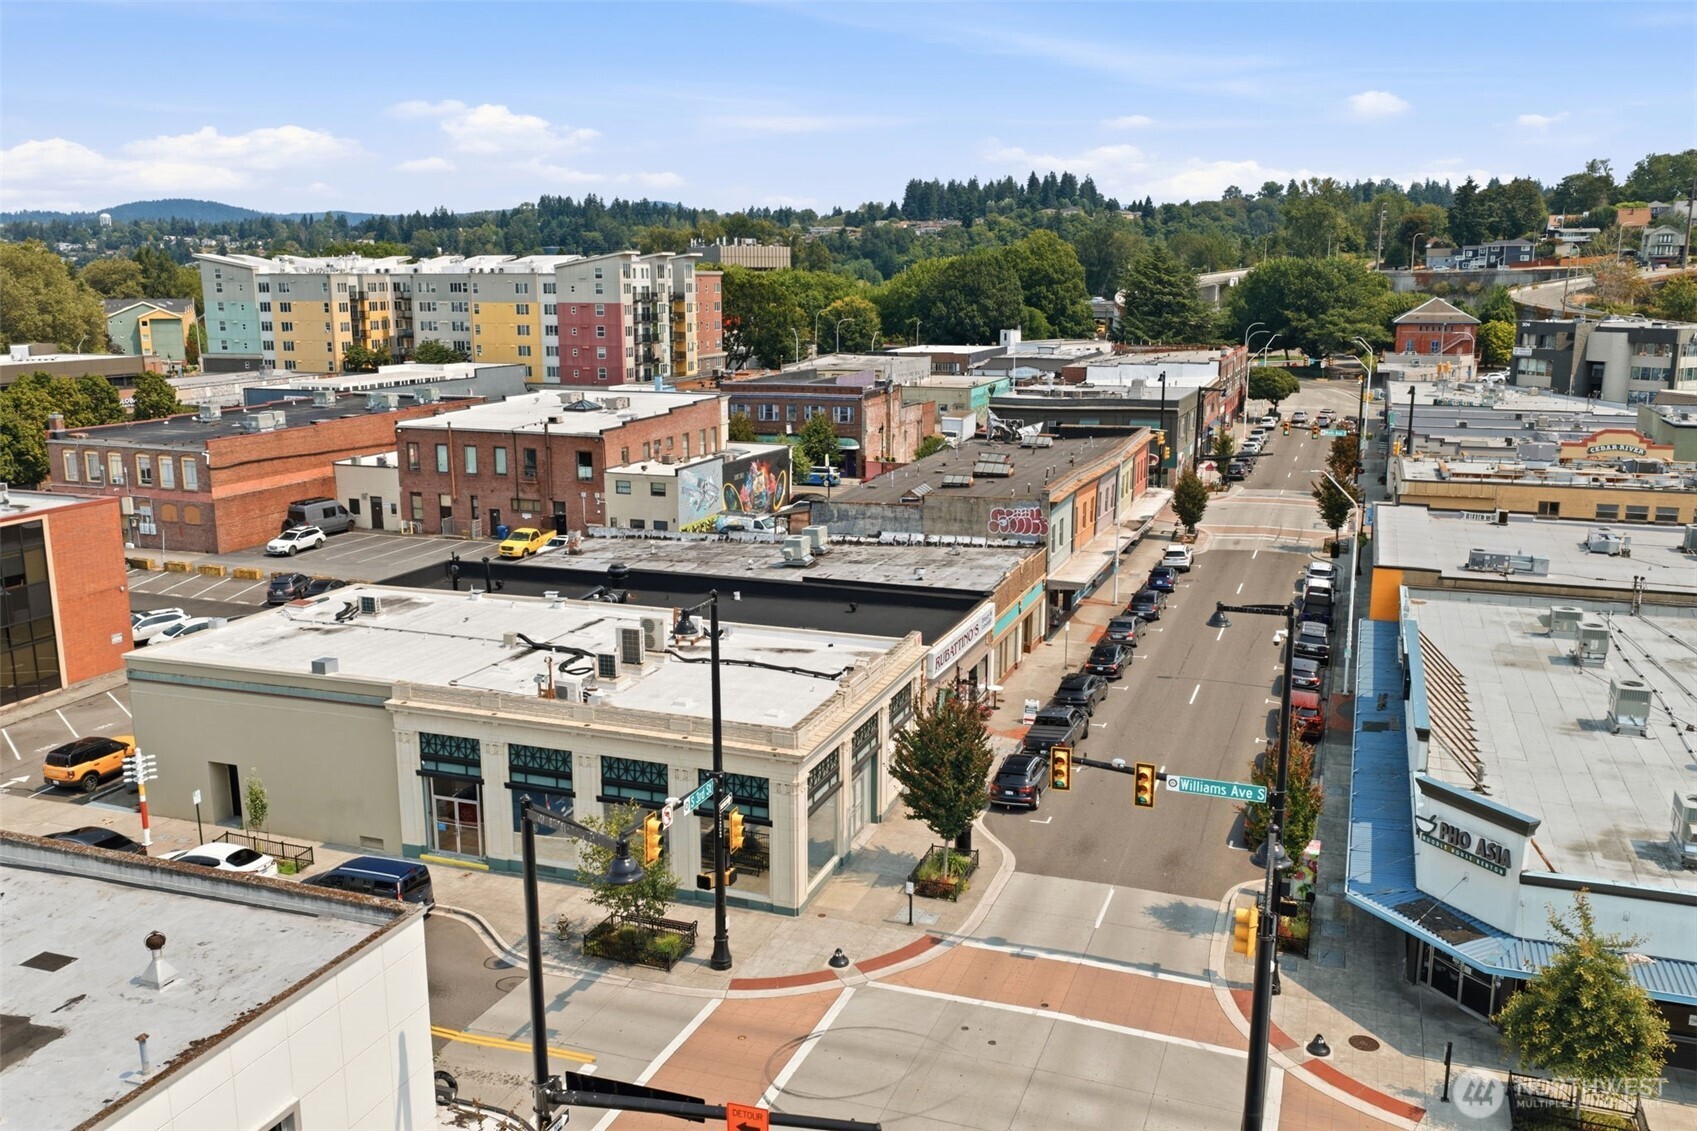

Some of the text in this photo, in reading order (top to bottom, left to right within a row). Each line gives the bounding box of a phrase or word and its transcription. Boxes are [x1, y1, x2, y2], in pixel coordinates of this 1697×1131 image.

[1590, 445, 1645, 455] CEDAR RIVER
[935, 623, 979, 670] RUBATTINO'S
[690, 795, 695, 808] S
[696, 789, 705, 804] 3rd
[706, 782, 712, 796] St
[1180, 778, 1265, 801] Williams Ave S
[1422, 835, 1504, 875] NOODLE HOUSE RENTON
[1439, 821, 1512, 869] PHO ASIA
[732, 1108, 763, 1121] DETOUR
